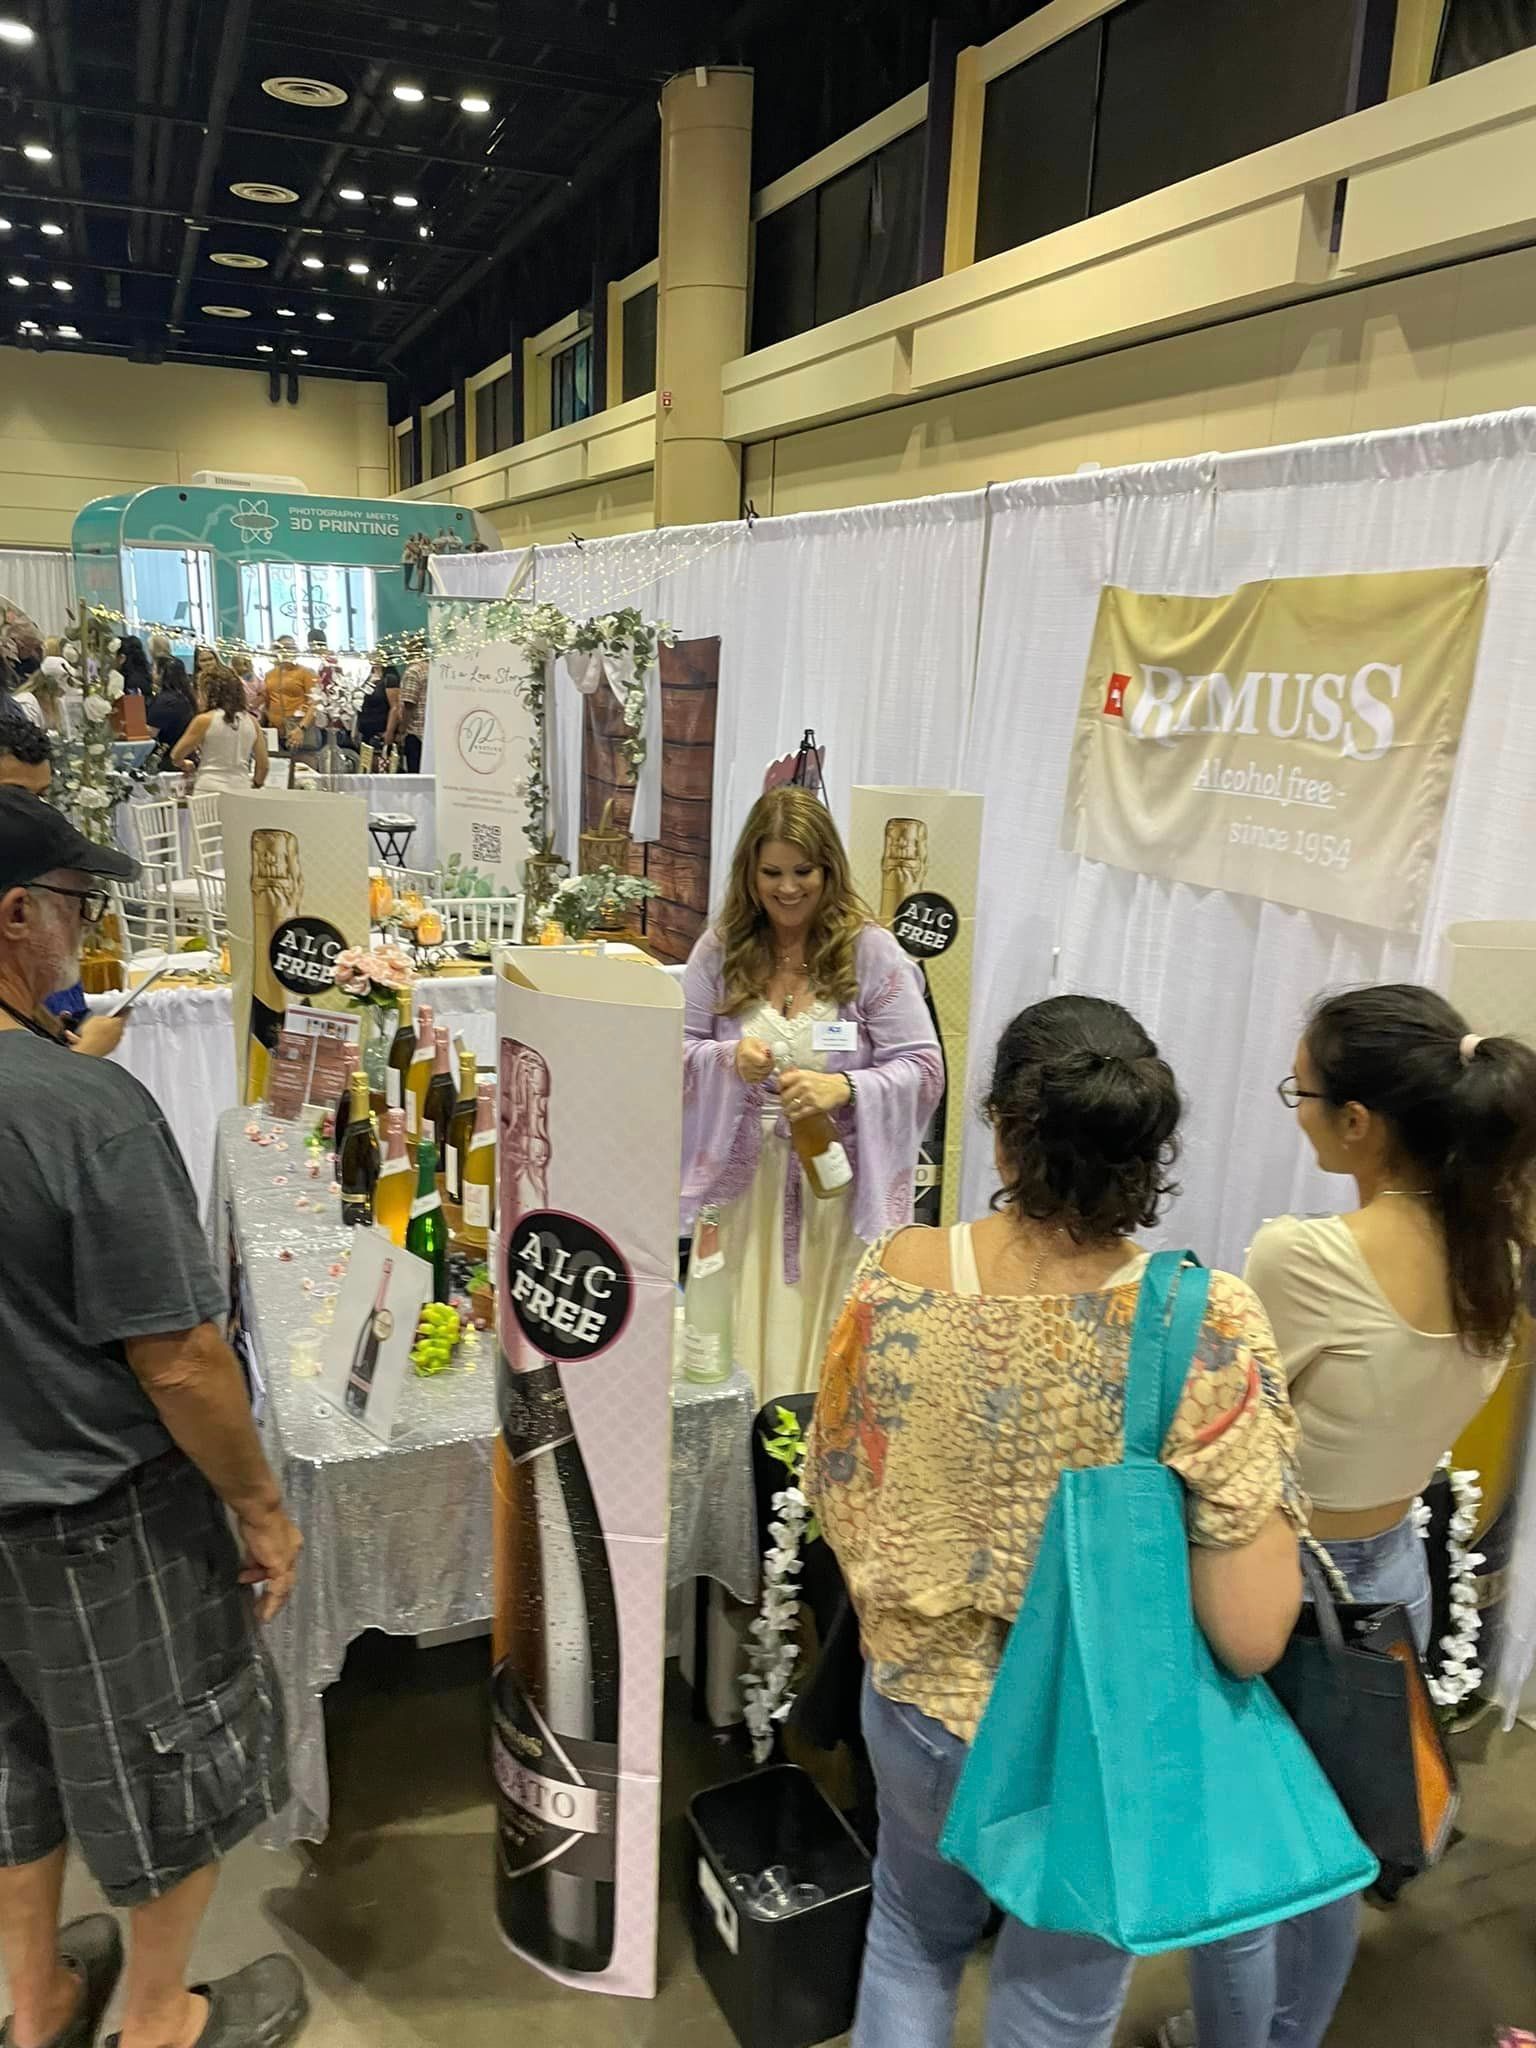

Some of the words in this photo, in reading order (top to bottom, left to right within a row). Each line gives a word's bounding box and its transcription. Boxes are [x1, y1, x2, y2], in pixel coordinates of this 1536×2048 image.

[288, 506, 363, 519] PHOTOGRAPHY
[365, 511, 400, 522] MEETS
[290, 517, 312, 531] 3D
[319, 519, 400, 537] PRINTING
[1130, 662, 1403, 761] RIMUSS
[1195, 759, 1281, 797] Alcohol
[1229, 815, 1289, 851] since
[1293, 829, 1352, 869] 1954
[904, 903, 953, 929] ALC
[279, 929, 341, 960] ALC
[896, 921, 948, 949] FREE
[518, 1231, 617, 1299] ALC
[511, 1269, 608, 1344] FREE
